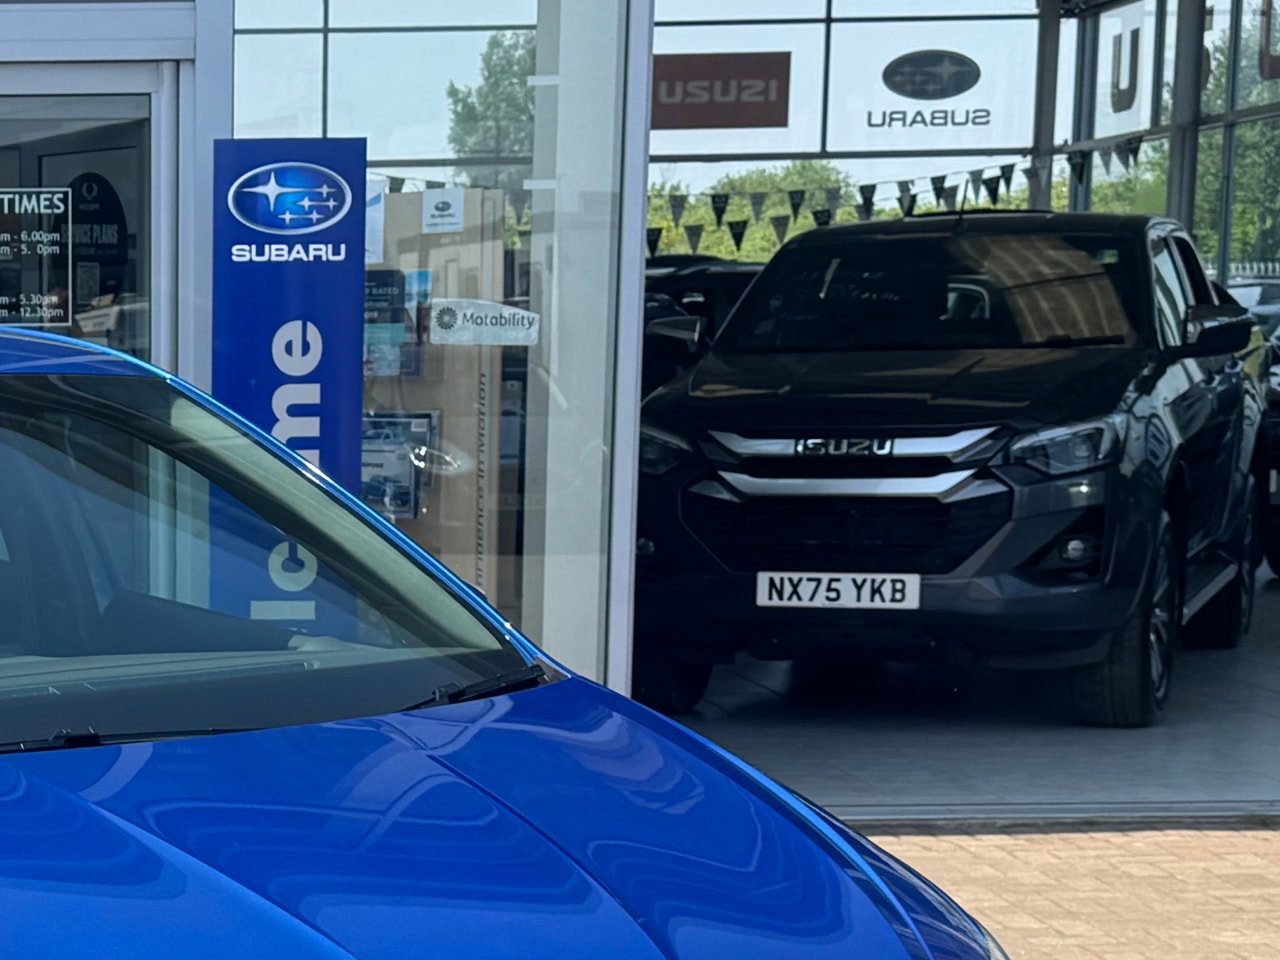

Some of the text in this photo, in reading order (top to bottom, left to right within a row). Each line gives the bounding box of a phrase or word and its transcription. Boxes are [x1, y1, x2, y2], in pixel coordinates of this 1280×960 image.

[20, 230, 60, 243] 6.00pm
[231, 244, 346, 262] SUBARU
[462, 312, 535, 330] Motability
[796, 438, 892, 456] ISUZU
[768, 577, 907, 603] NX75 YKB
